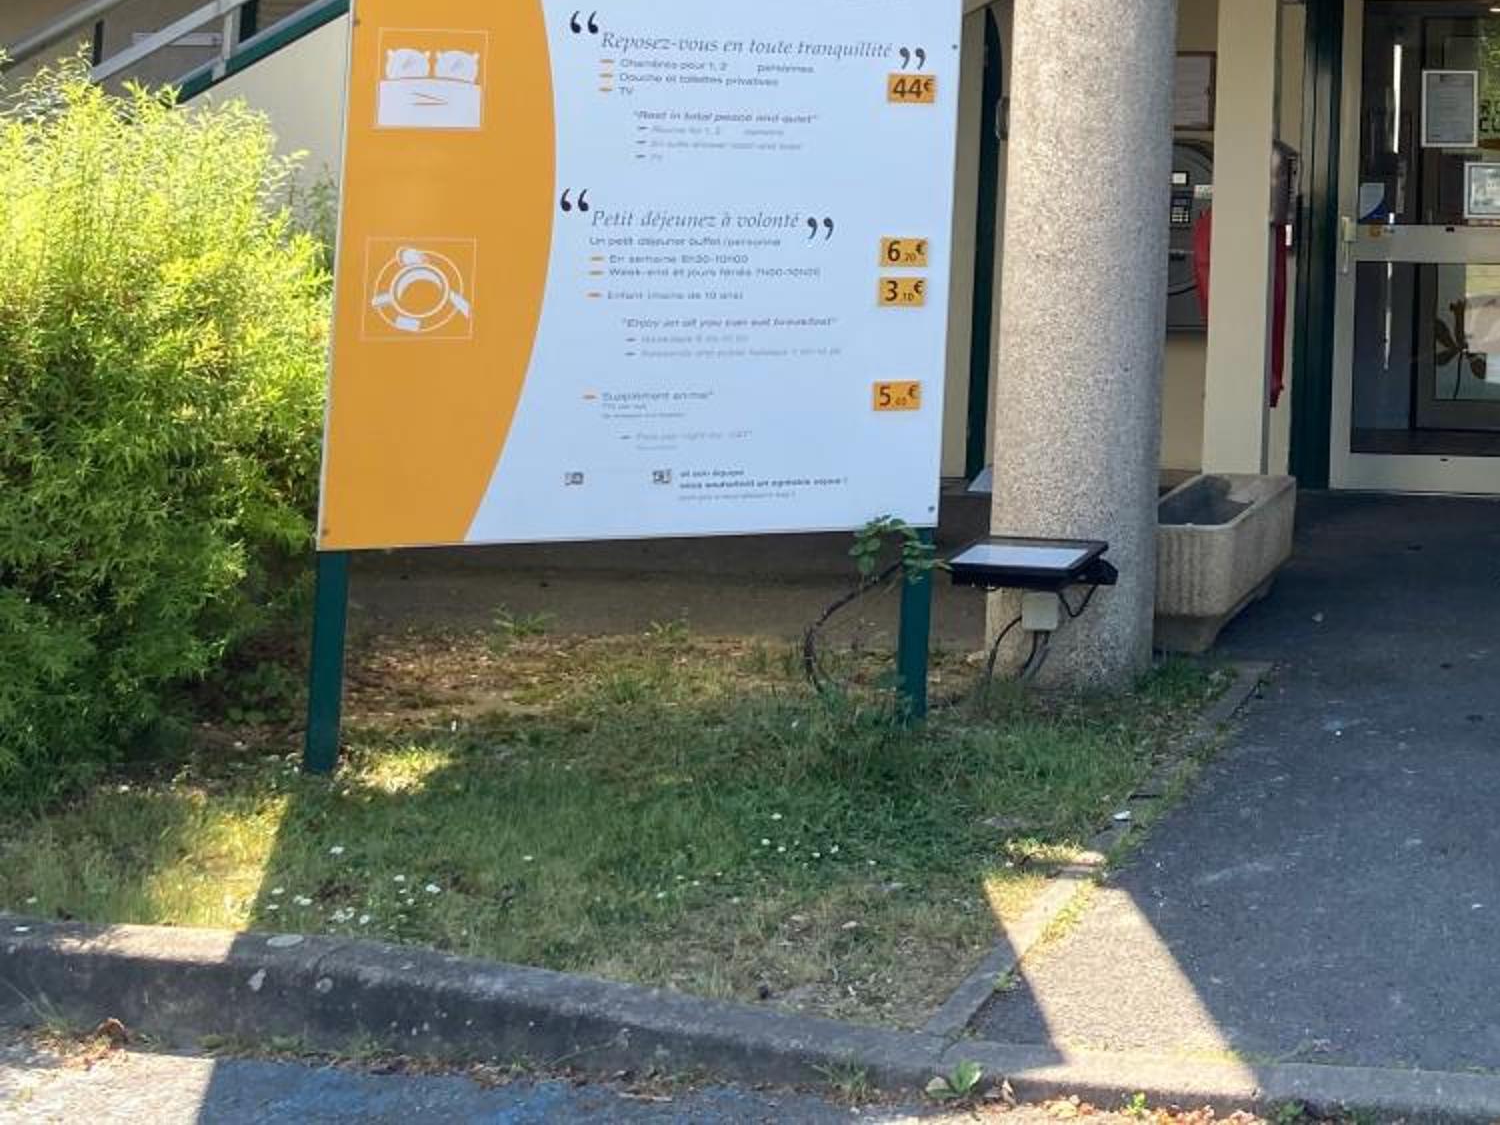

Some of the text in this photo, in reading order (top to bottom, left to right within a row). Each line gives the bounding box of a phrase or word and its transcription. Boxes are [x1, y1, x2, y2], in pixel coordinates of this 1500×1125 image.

[723, 39, 743, 52] en
[892, 78, 934, 98] 44€
[592, 210, 633, 227] Petit
[737, 212, 799, 229] volonté
